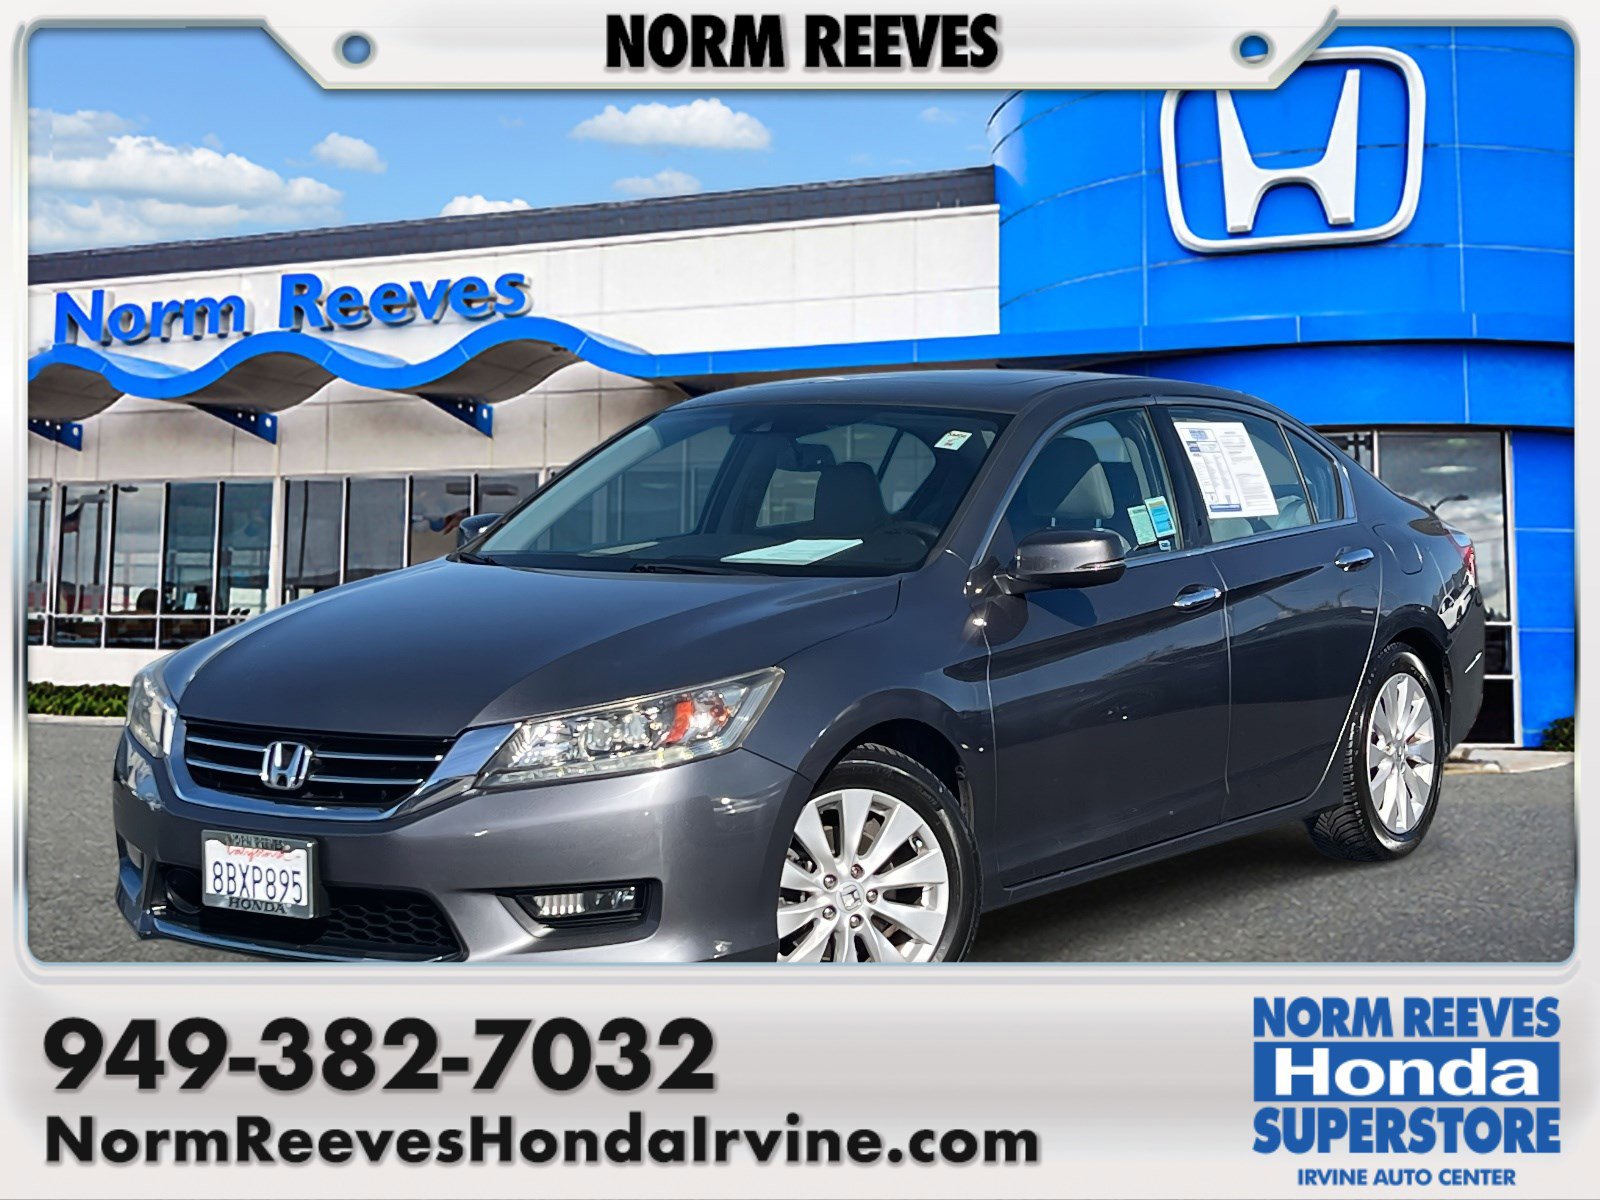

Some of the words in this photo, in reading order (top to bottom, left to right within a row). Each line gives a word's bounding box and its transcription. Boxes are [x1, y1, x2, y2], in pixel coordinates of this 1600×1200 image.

[55, 288, 248, 346] Norm
[280, 271, 531, 330] Reeves
[212, 860, 303, 904] 8BXP895
[228, 896, 288, 915] HONDA
